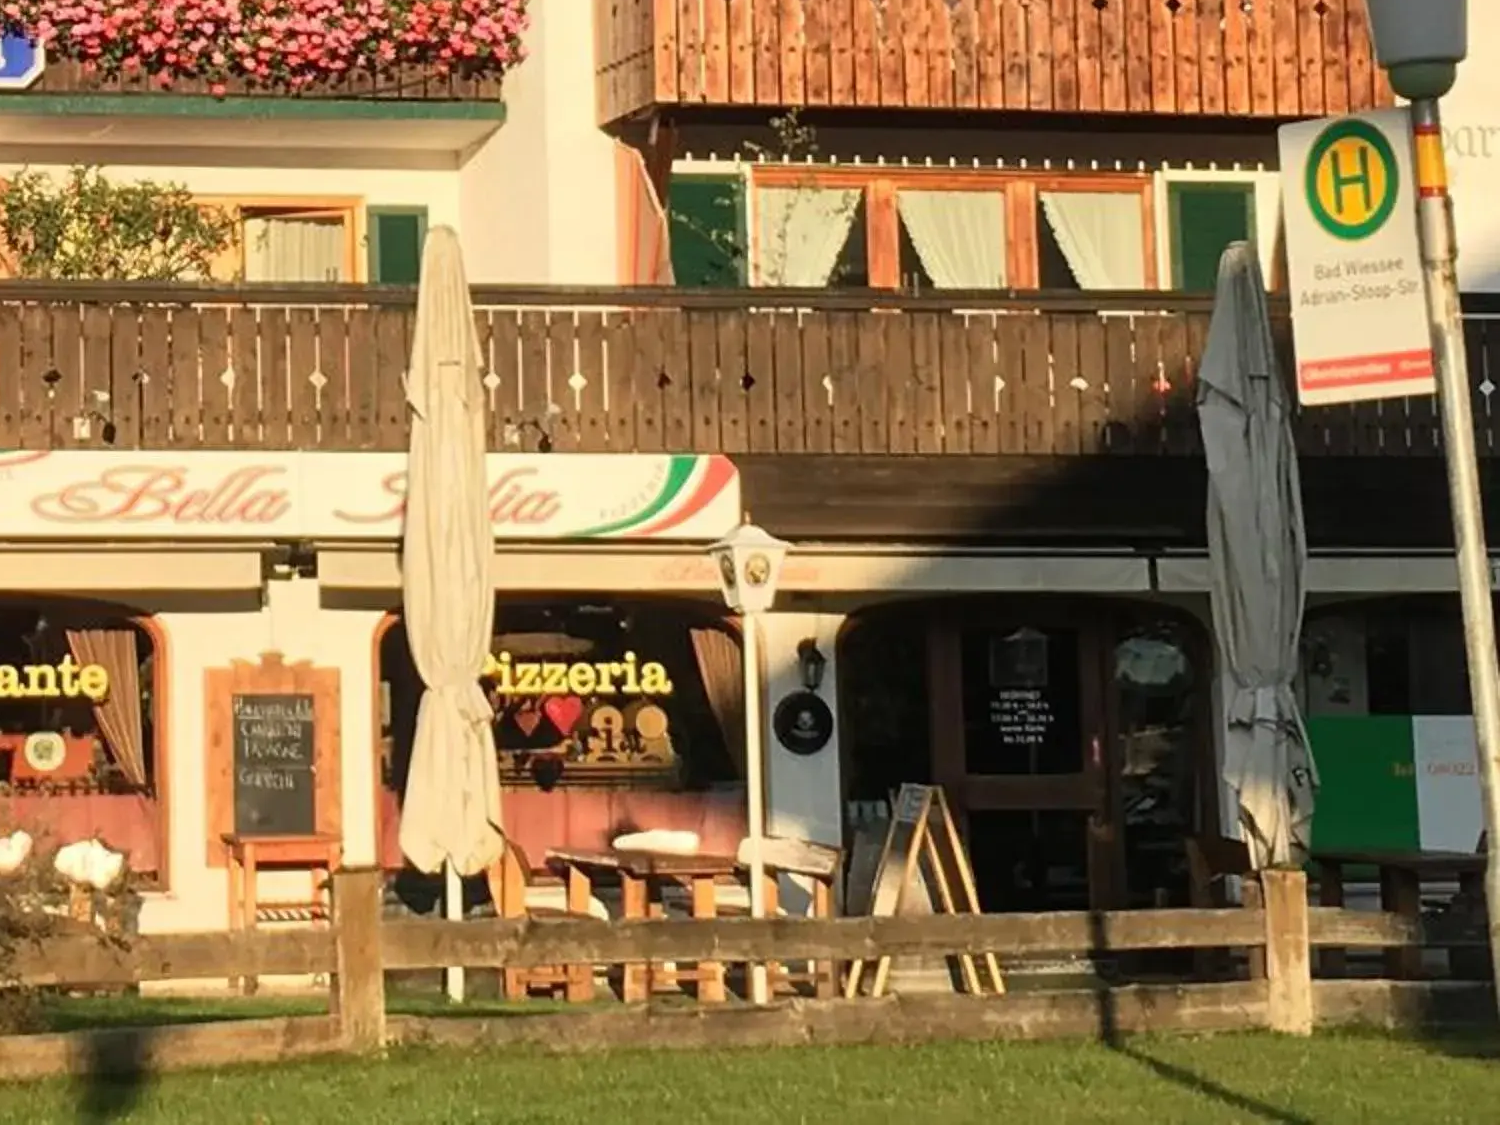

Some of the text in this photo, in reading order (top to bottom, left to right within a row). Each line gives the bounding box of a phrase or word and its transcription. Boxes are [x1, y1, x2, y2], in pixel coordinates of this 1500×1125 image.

[1329, 145, 1372, 215] H
[1314, 256, 1404, 281] Bad Wiessee
[29, 464, 292, 525] Bella
